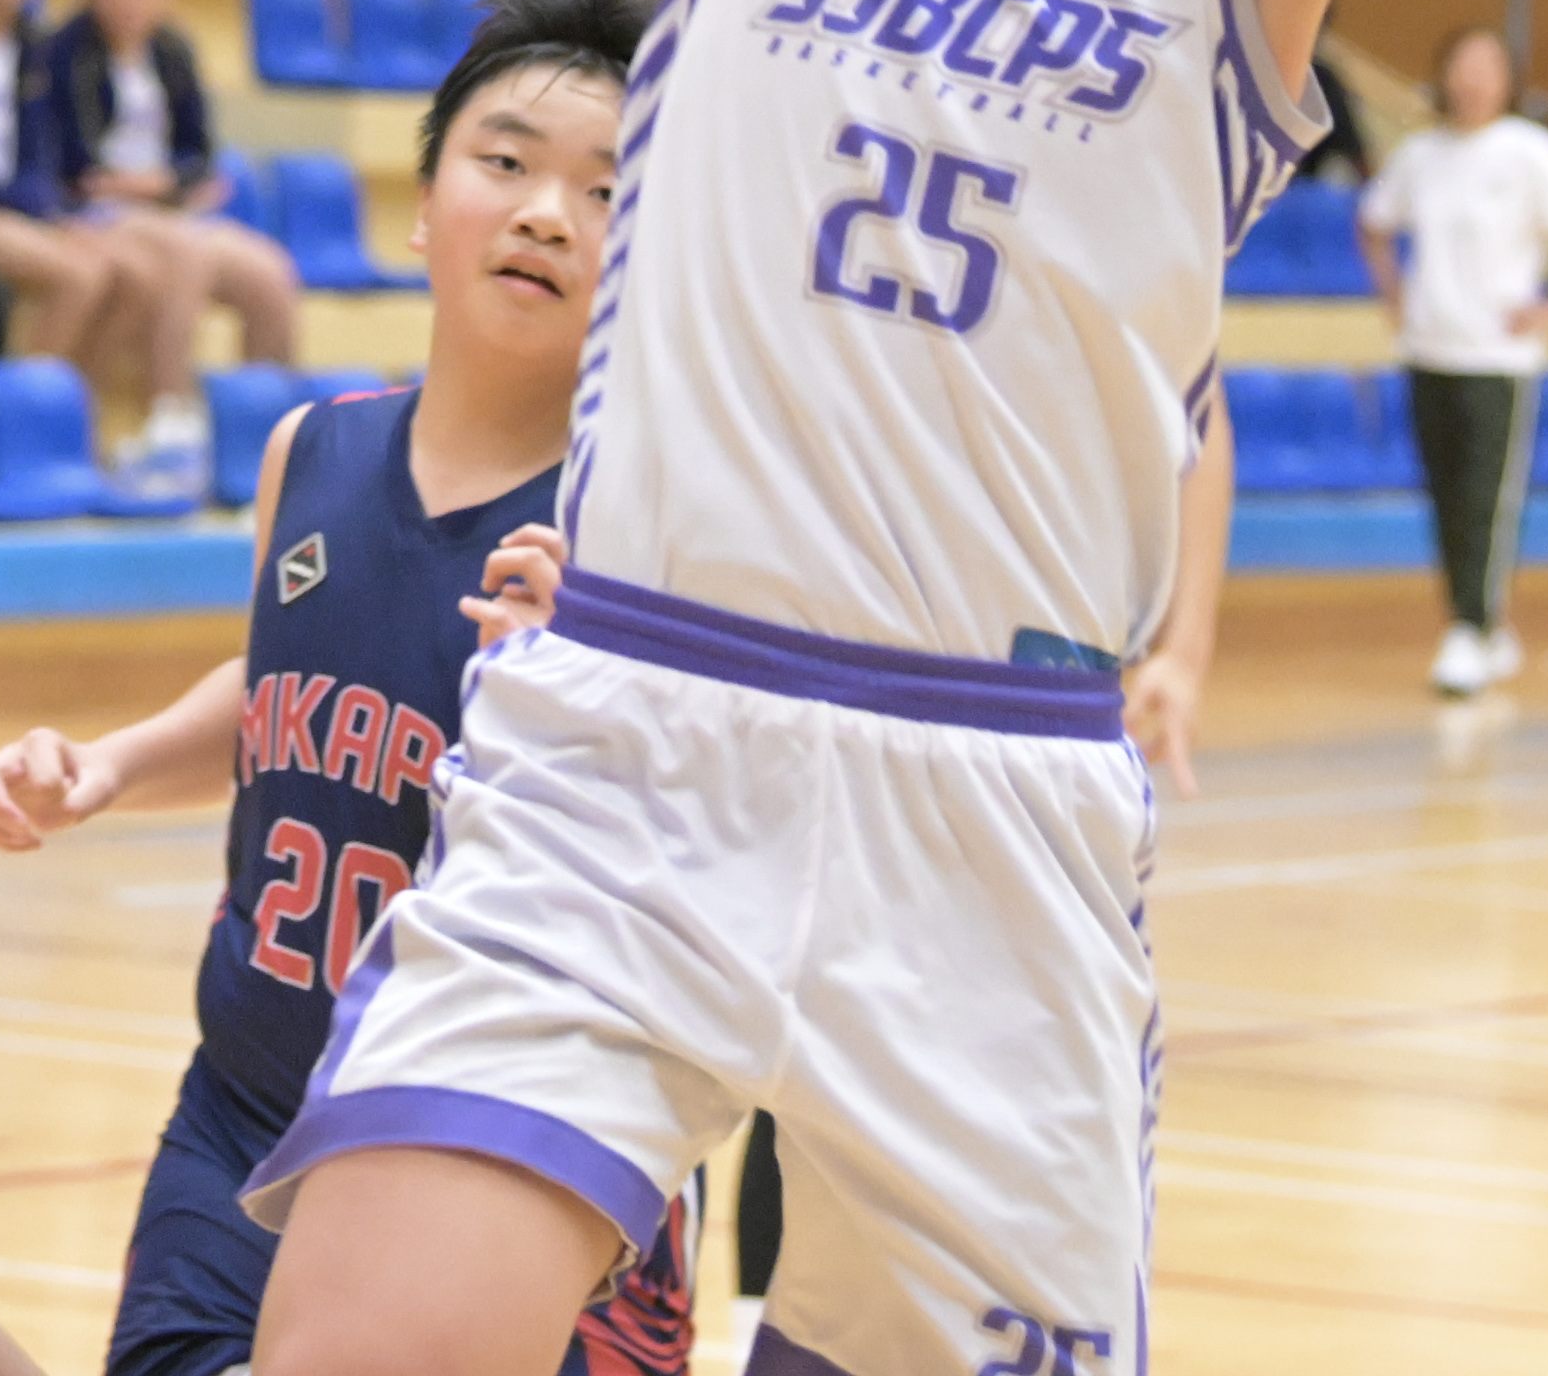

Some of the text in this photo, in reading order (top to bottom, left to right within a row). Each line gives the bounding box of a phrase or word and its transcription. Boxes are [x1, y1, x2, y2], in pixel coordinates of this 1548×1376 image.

[766, 34, 1094, 143] BASKETBALL
[808, 118, 1024, 338] 25
[249, 816, 412, 997] 20
